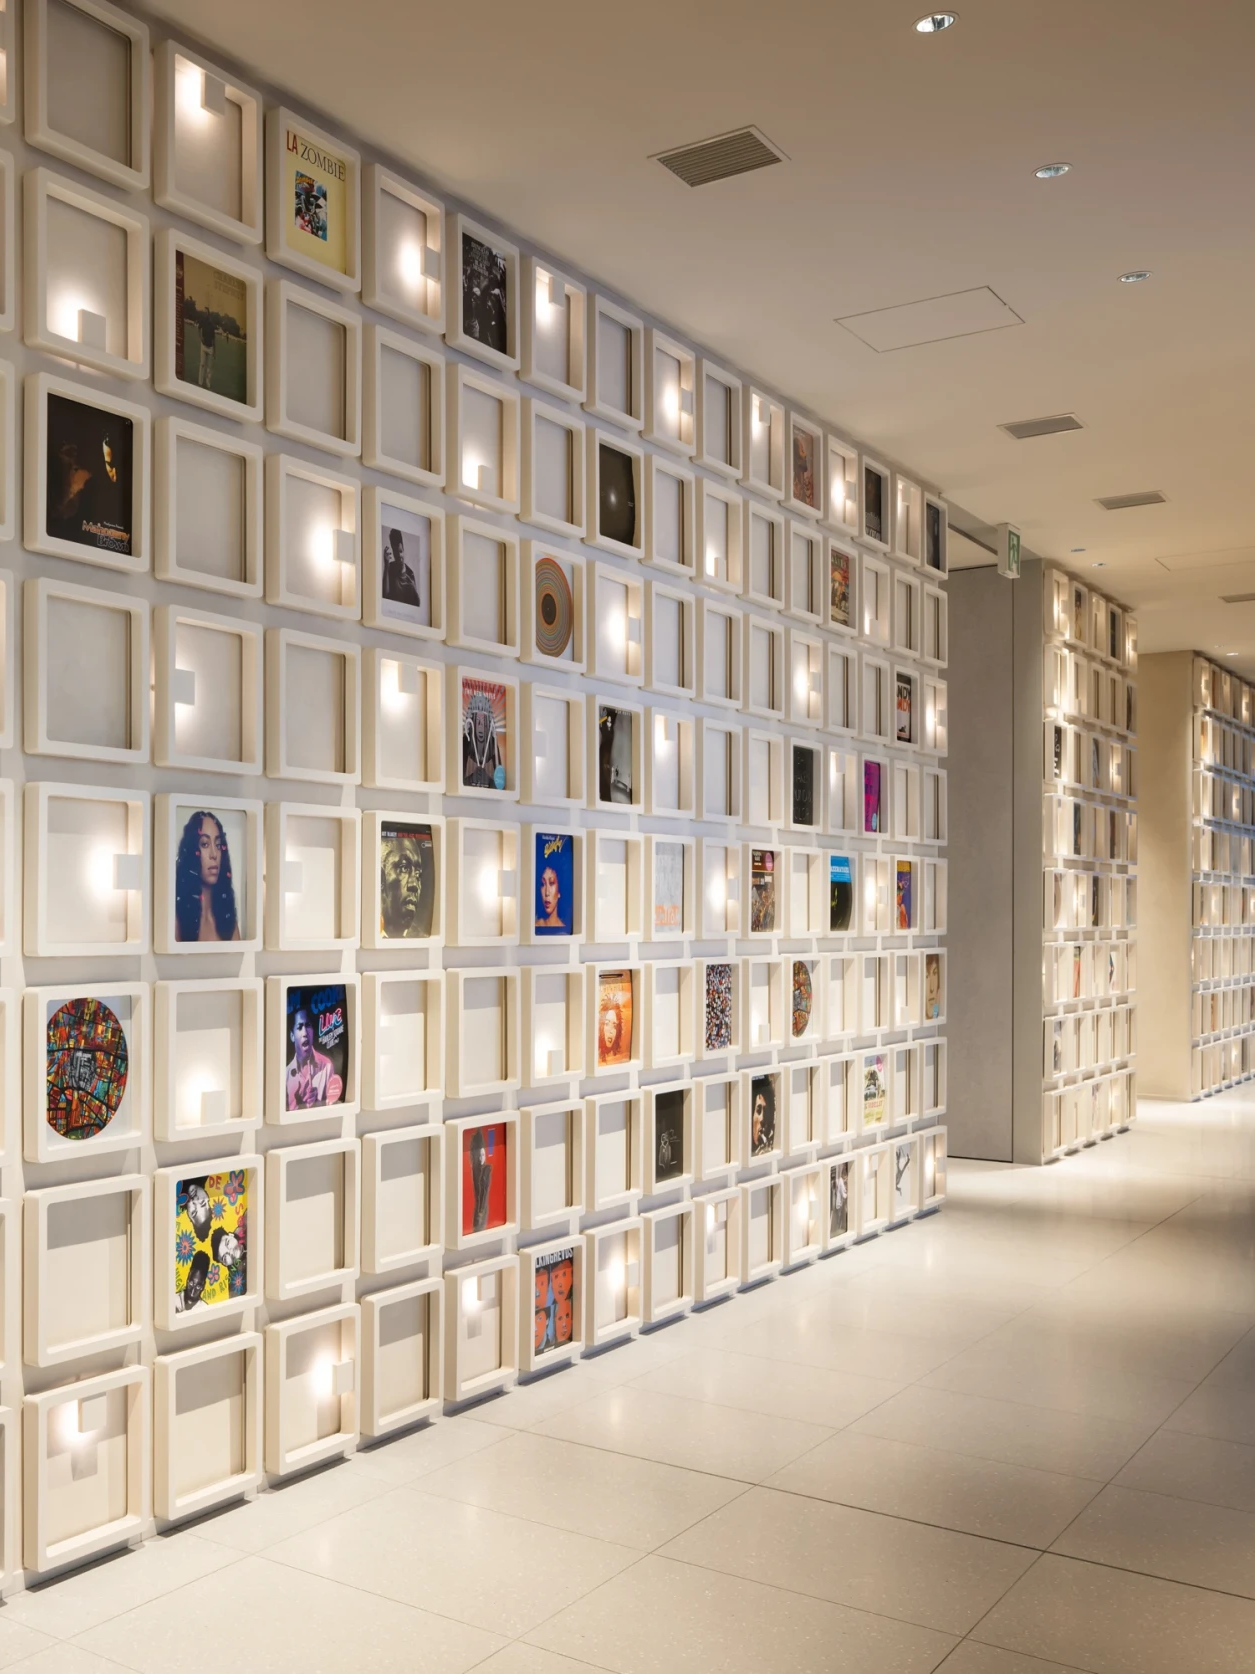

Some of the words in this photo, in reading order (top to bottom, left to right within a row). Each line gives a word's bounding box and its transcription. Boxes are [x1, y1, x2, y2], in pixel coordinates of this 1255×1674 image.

[286, 130, 298, 155] LA
[300, 142, 346, 182] ZOMBIE
[209, 1175, 222, 1191] DE
